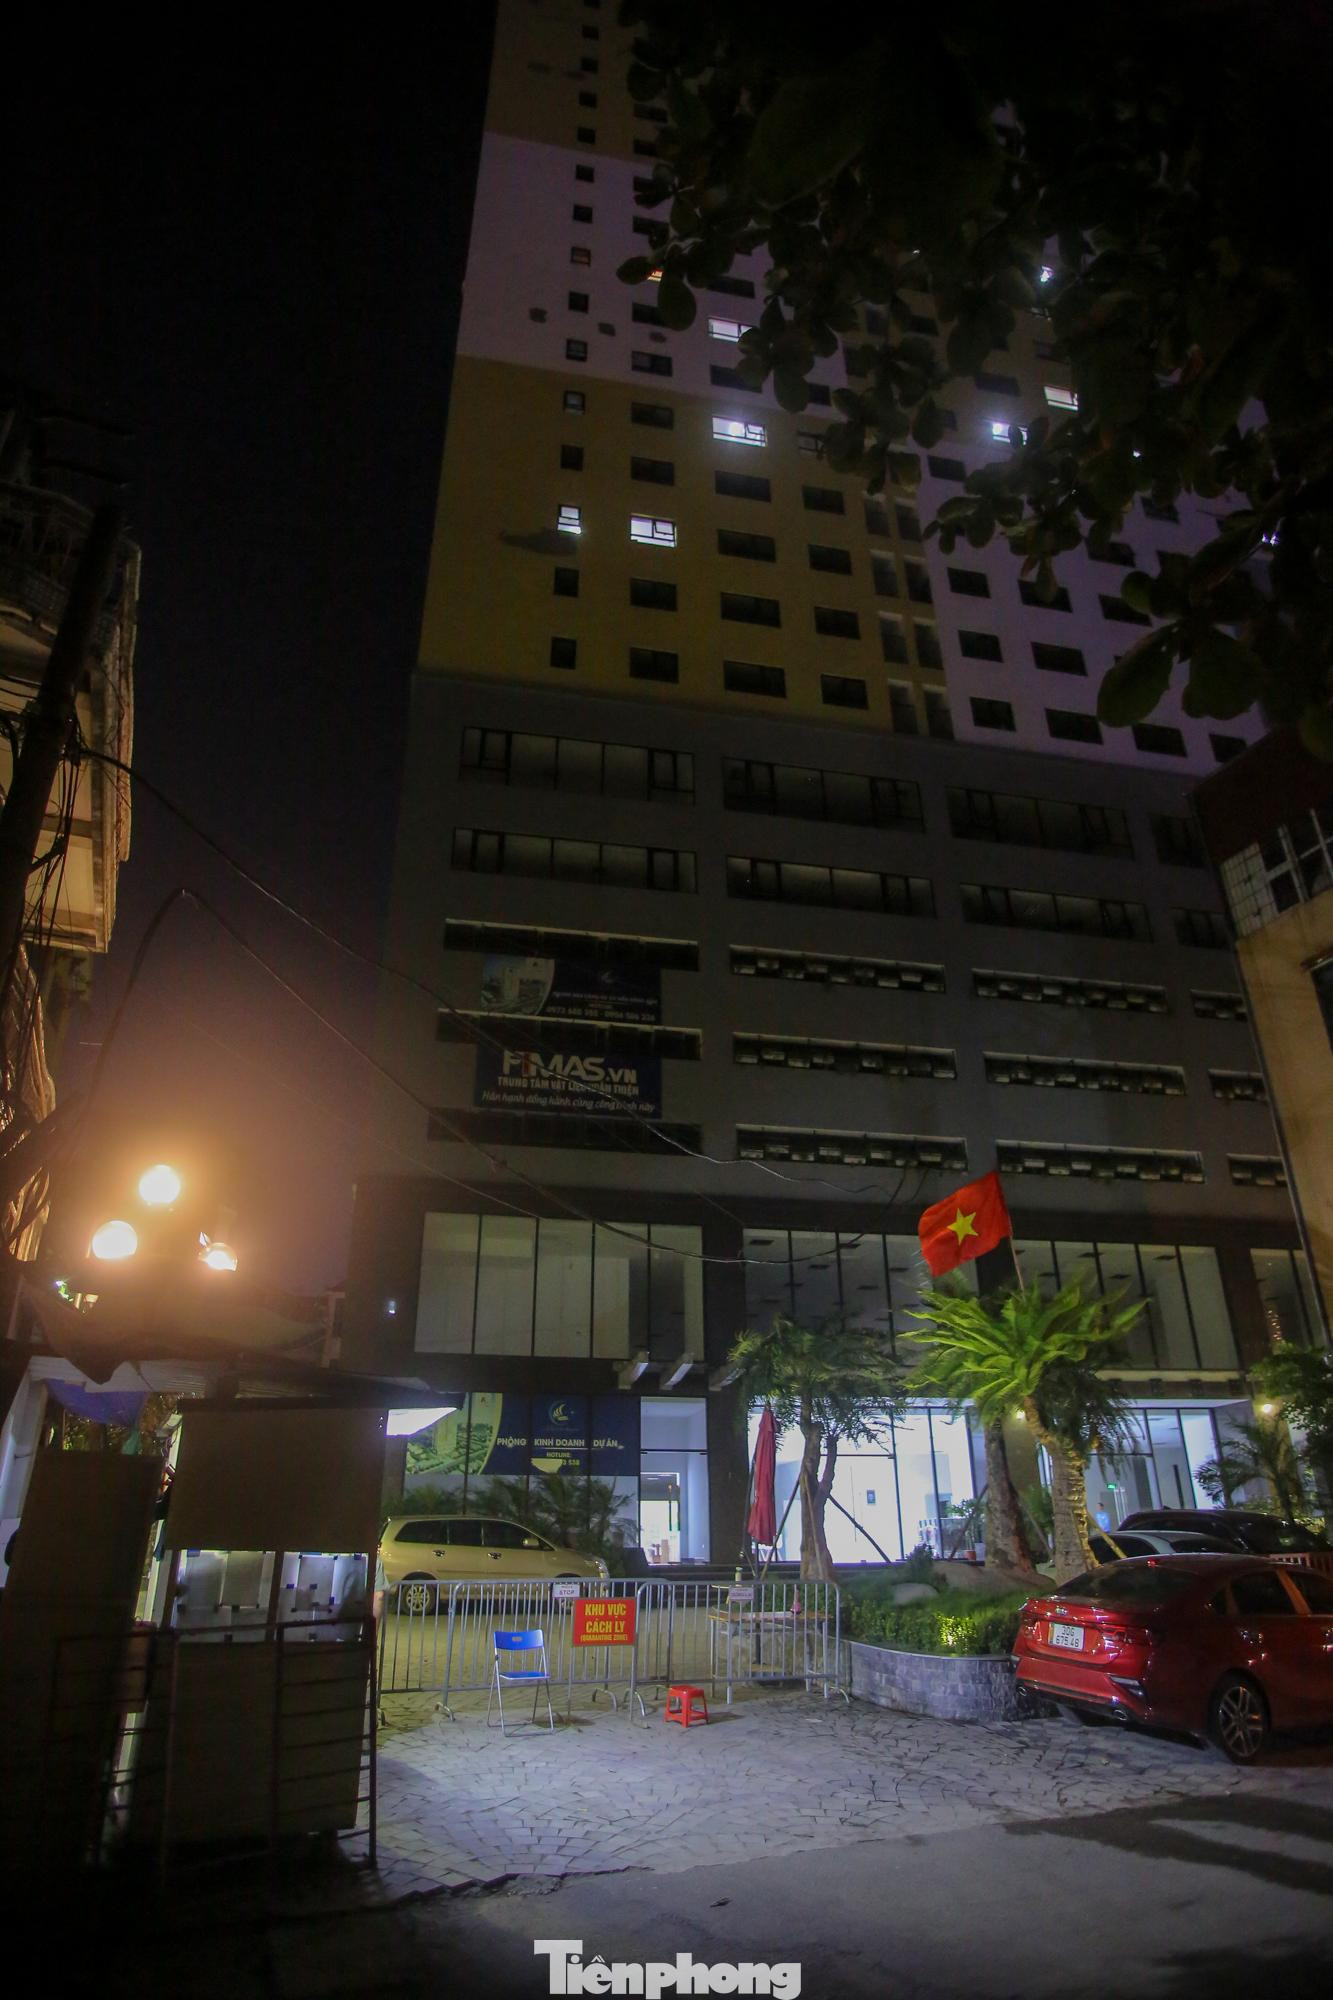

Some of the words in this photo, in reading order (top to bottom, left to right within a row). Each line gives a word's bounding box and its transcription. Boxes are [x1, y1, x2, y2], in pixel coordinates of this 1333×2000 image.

[534, 1438, 554, 1447] KINH
[555, 1438, 585, 1447] DOANH
[585, 1603, 605, 1616] KHU
[607, 1602, 627, 1618] VỰC
[585, 1618, 612, 1633] CÁCH
